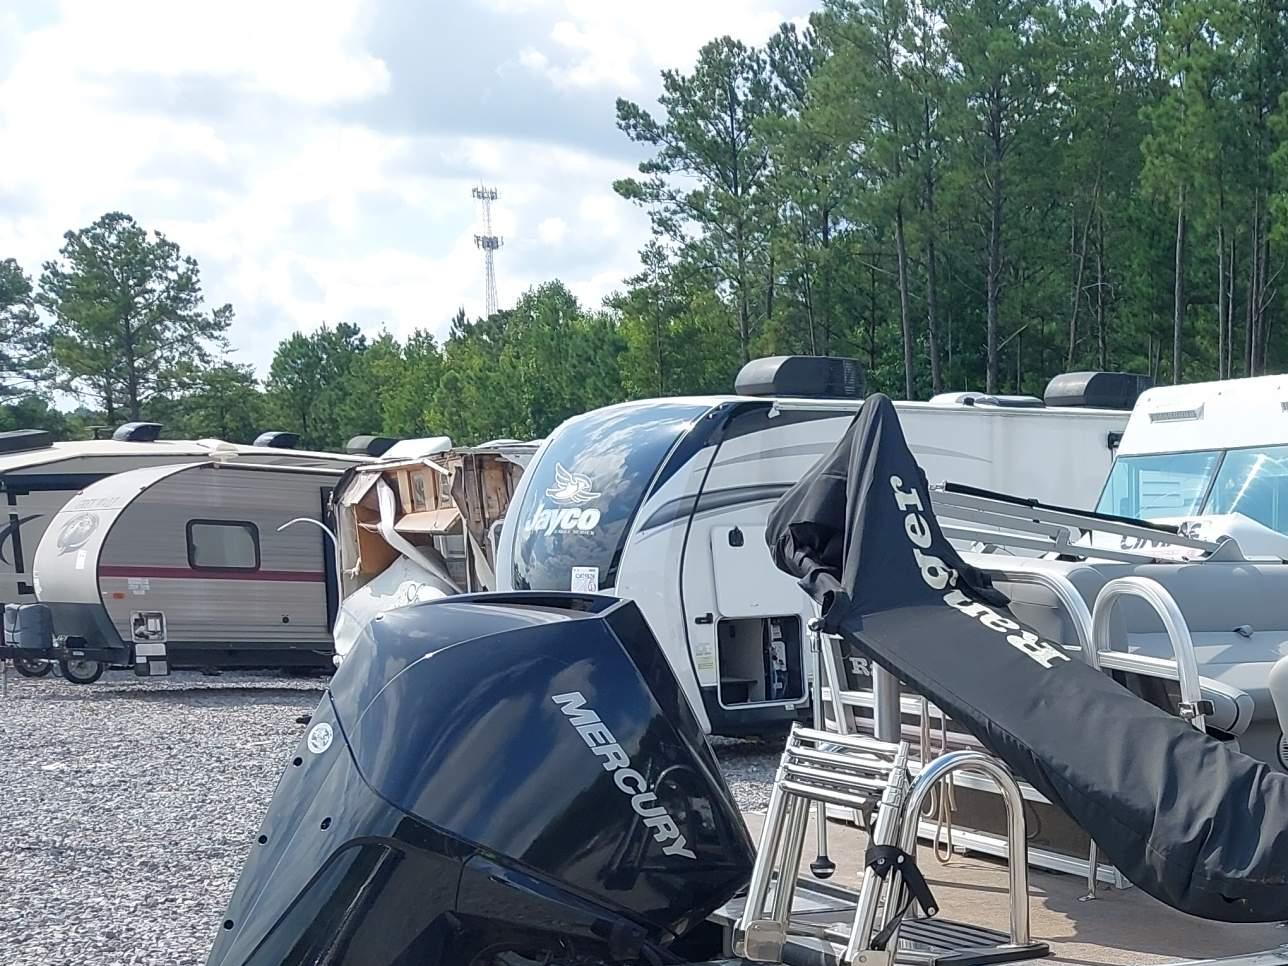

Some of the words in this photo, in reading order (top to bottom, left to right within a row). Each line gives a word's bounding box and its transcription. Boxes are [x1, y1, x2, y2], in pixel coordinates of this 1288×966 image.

[524, 504, 601, 536] Jayco
[889, 475, 1072, 669] Ranger
[551, 691, 697, 860] MERCURY
